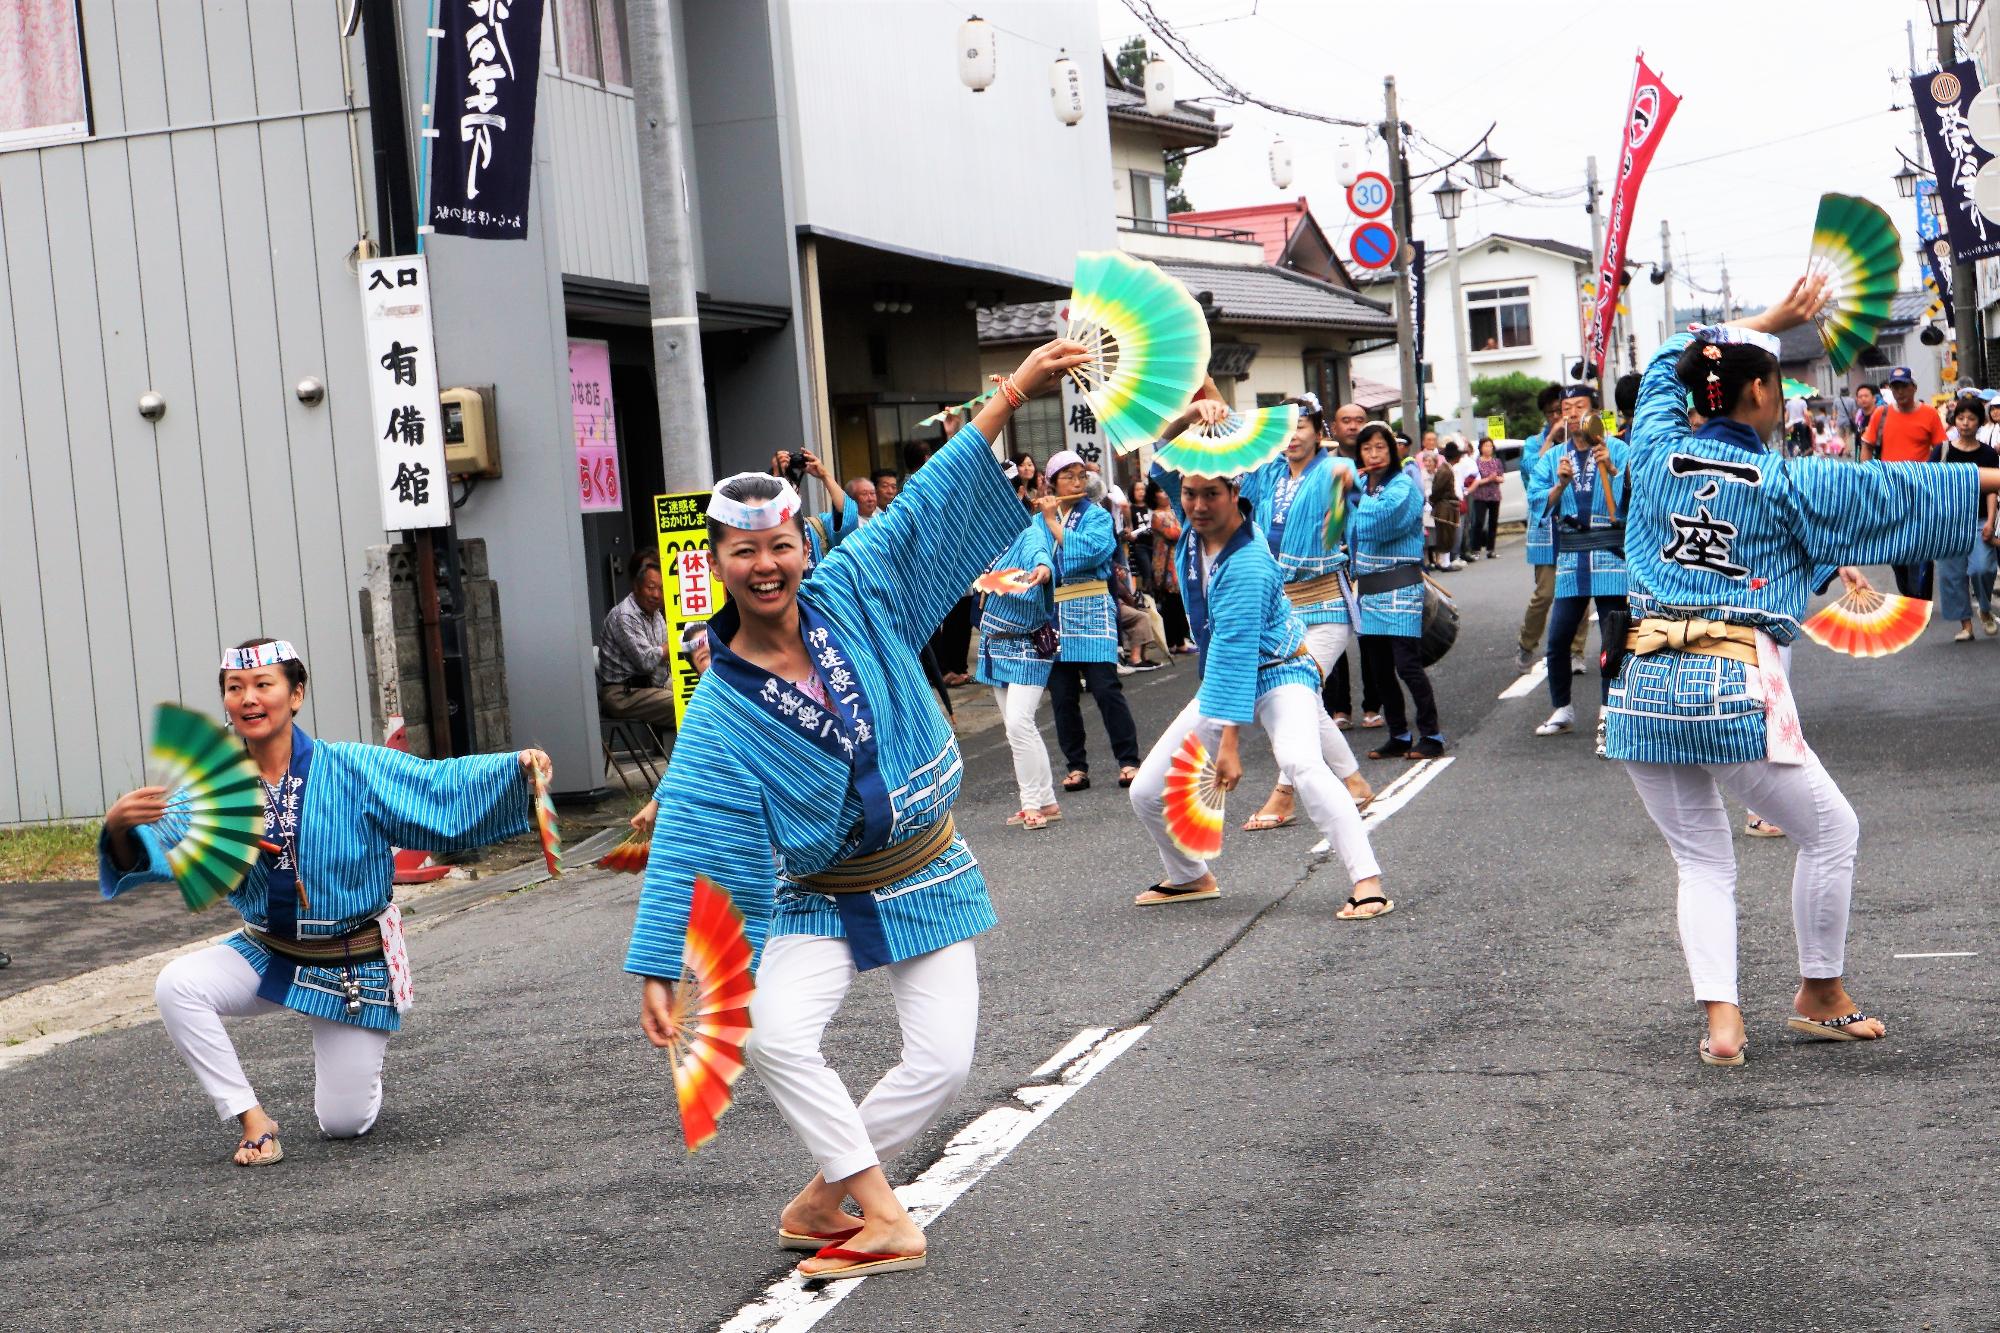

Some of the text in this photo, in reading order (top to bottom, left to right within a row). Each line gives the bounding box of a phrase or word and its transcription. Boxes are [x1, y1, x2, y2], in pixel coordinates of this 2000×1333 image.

[1357, 183, 1384, 206] 30
[368, 267, 418, 291] 入口
[380, 340, 431, 507] 有備館
[659, 499, 698, 515] ご迷惑を
[660, 512, 708, 529] おかけしま
[682, 553, 707, 613] 休工中
